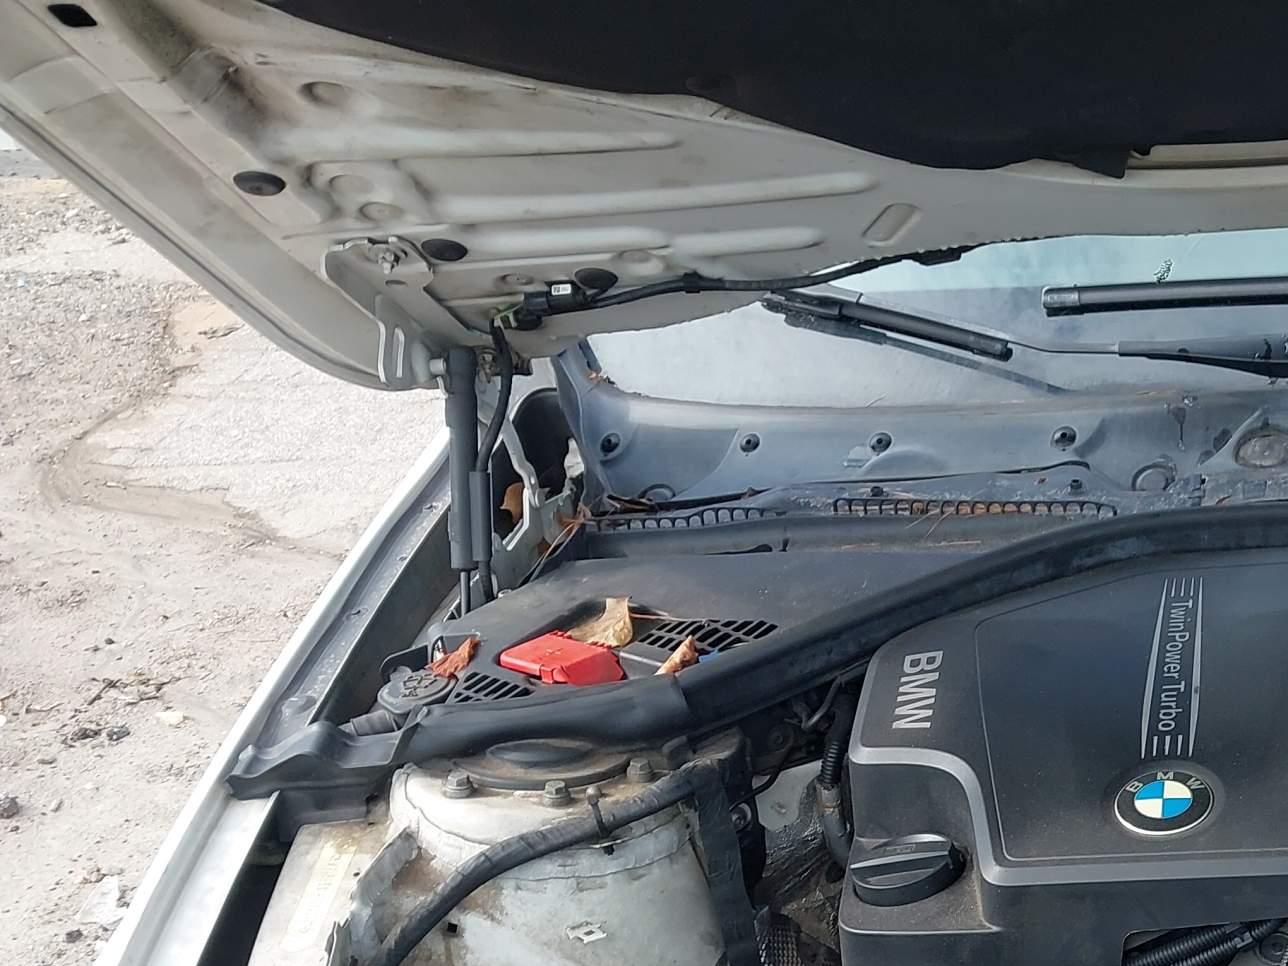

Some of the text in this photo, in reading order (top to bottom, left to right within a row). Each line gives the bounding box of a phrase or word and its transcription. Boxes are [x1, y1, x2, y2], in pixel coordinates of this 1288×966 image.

[892, 650, 943, 729] BMW
[1158, 599, 1193, 731] TwinPower Turbo
[1125, 771, 1205, 793] BMW
